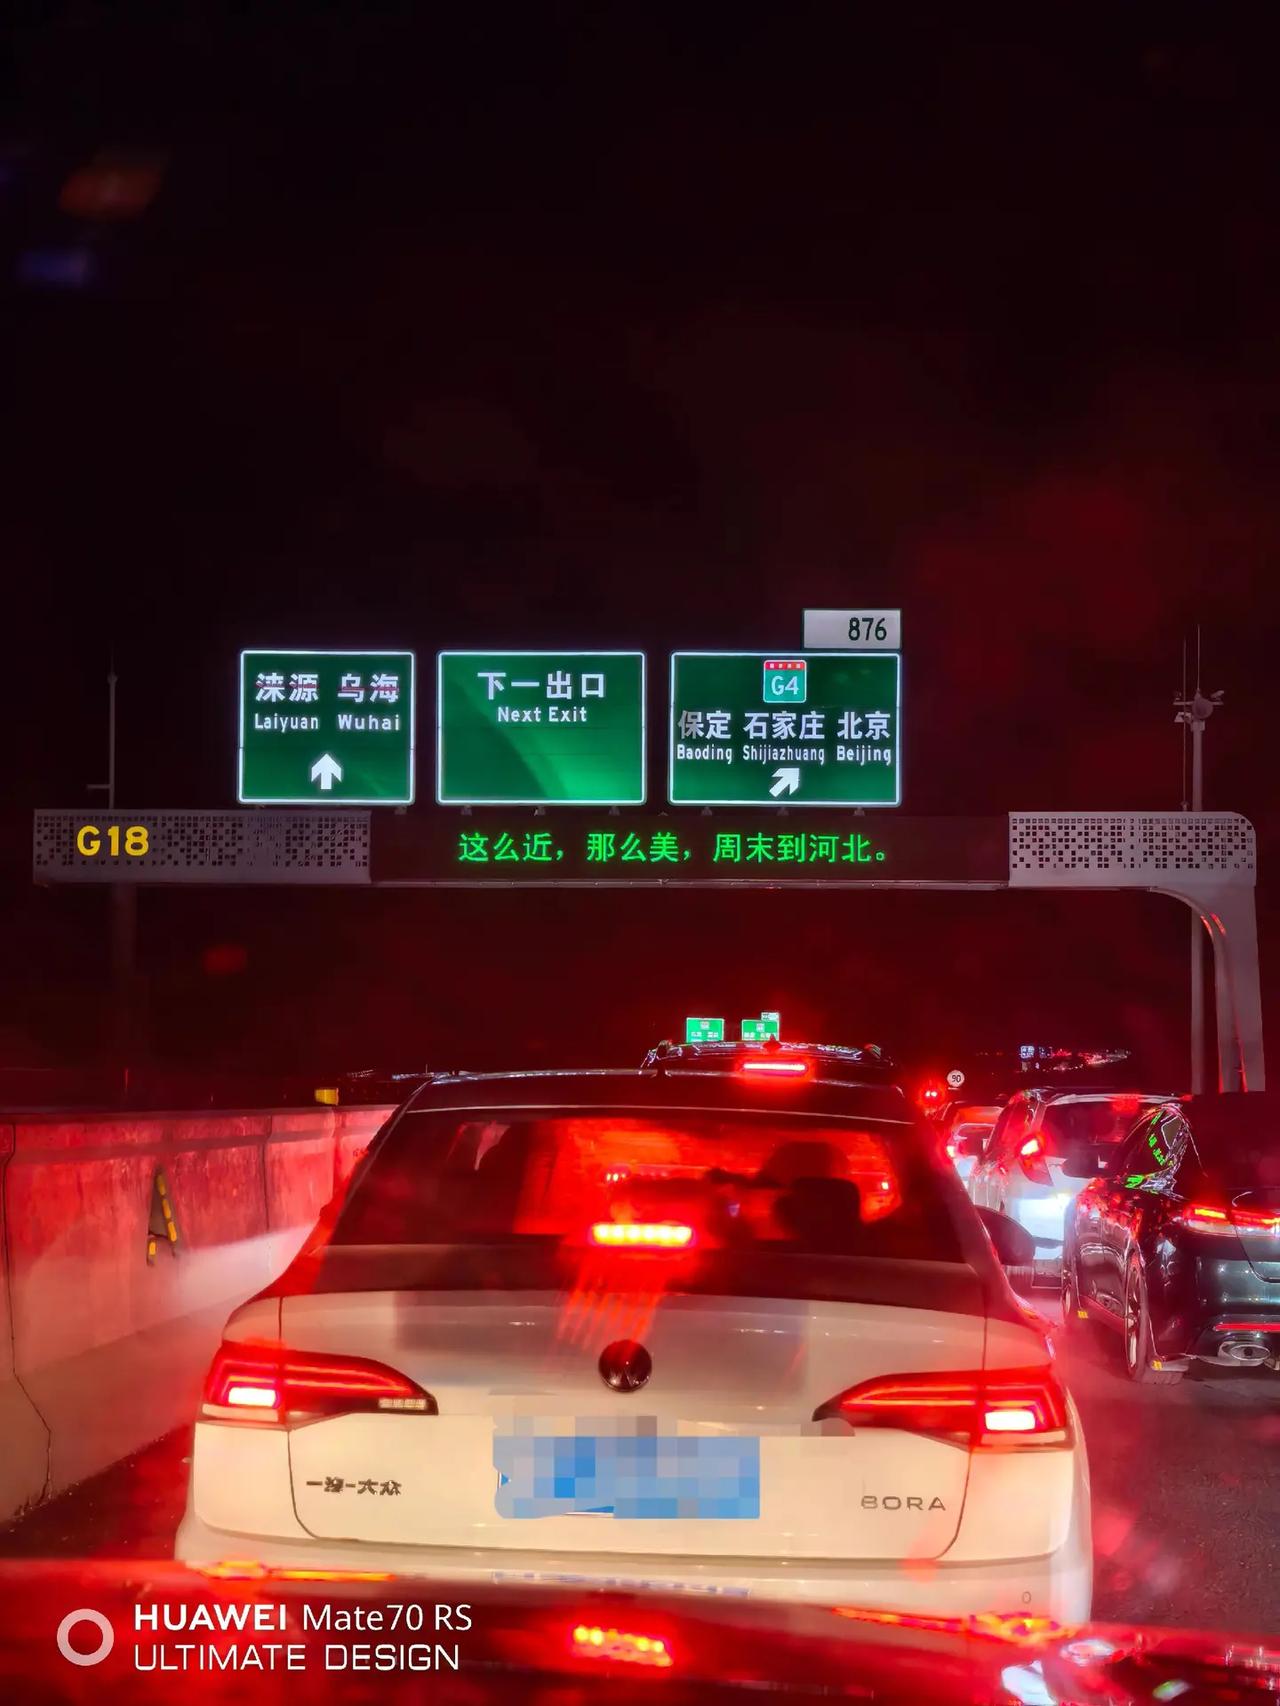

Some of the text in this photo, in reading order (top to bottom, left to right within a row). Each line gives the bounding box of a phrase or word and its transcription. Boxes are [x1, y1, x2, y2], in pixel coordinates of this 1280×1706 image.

[848, 616, 887, 642] 876
[255, 672, 400, 704] 涞源 乌海
[477, 670, 606, 701] 下一出口
[770, 674, 801, 697] G4
[254, 712, 401, 734] Laiyuan Wuhai
[497, 706, 587, 723] Next Exit
[677, 709, 891, 741] 保定 石家庄 北京
[676, 743, 892, 766] Baoding Shijiazhuang Beijing
[75, 825, 150, 858] G18
[951, 1074, 962, 1083] 90
[861, 1495, 947, 1511] BORA
